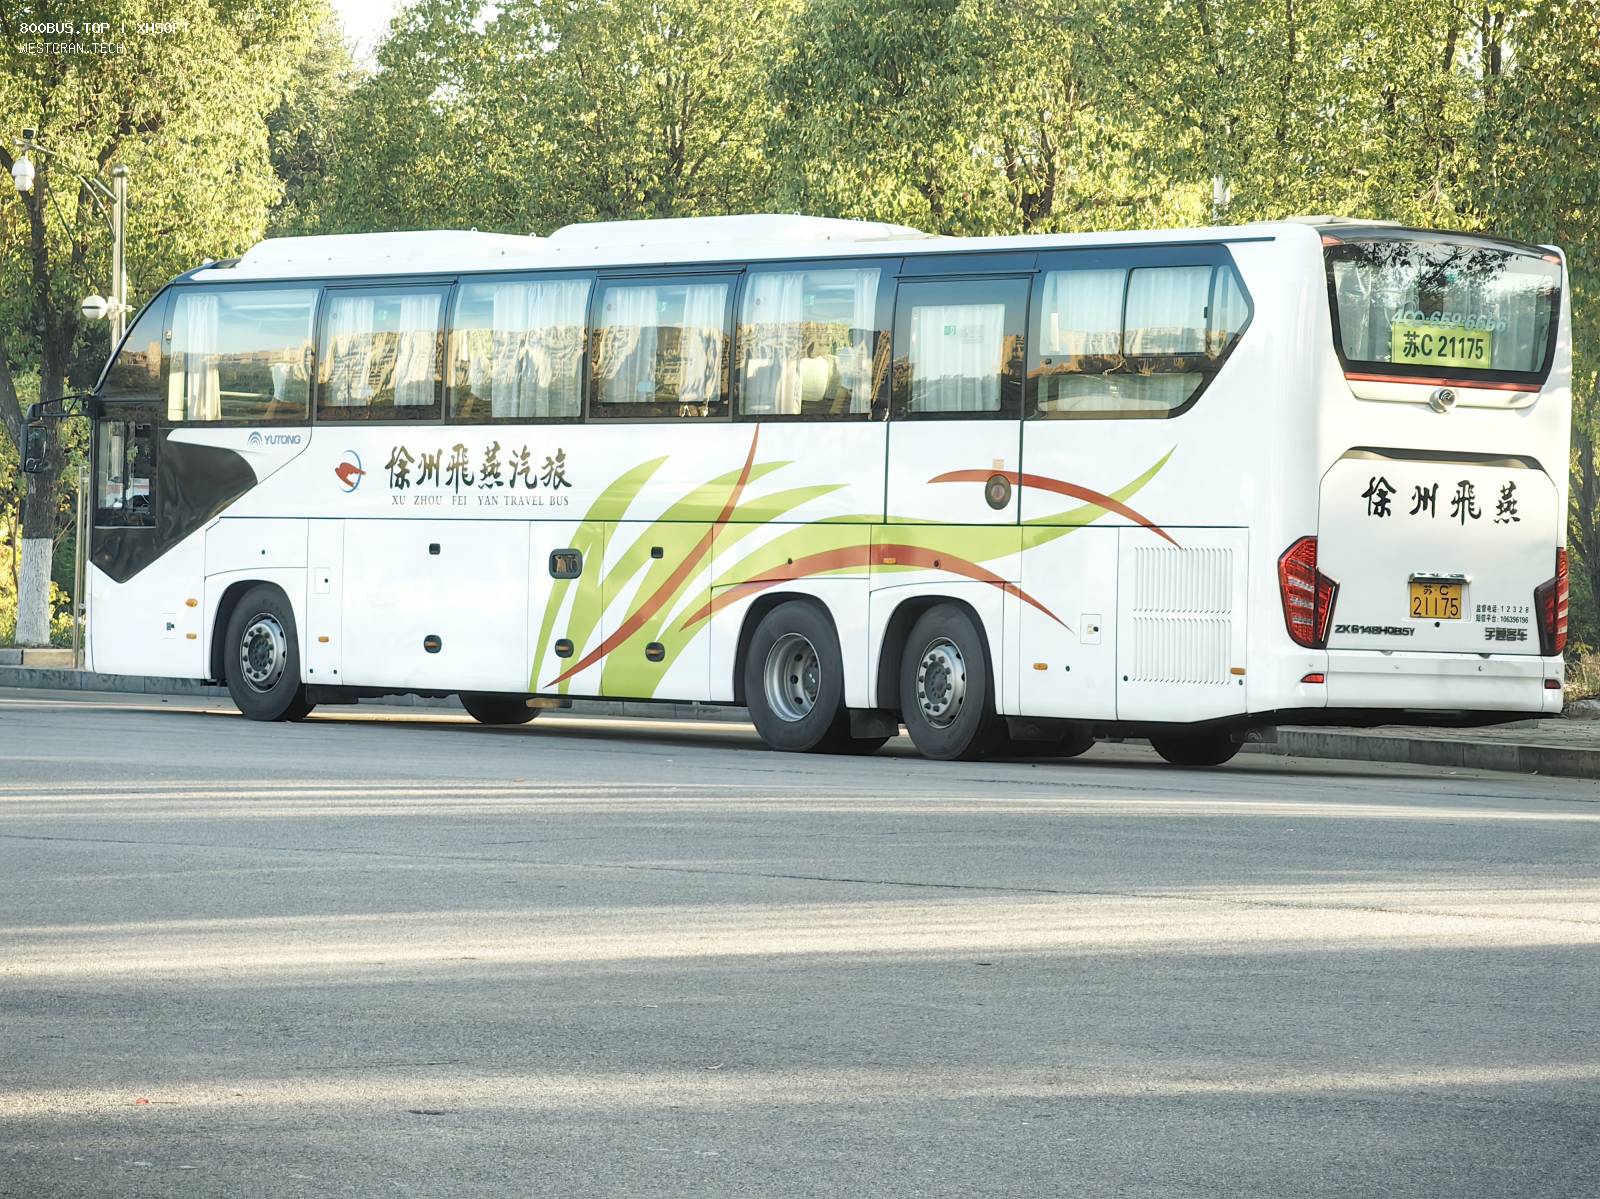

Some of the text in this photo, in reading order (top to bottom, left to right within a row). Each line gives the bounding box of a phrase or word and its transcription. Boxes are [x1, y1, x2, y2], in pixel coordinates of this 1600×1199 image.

[1438, 335, 1484, 360] 21175
[264, 434, 301, 445] YUTONG
[392, 495, 569, 506] XU ZHOU FEI YAN TRAVEL BUS
[1413, 596, 1459, 616] 21175
